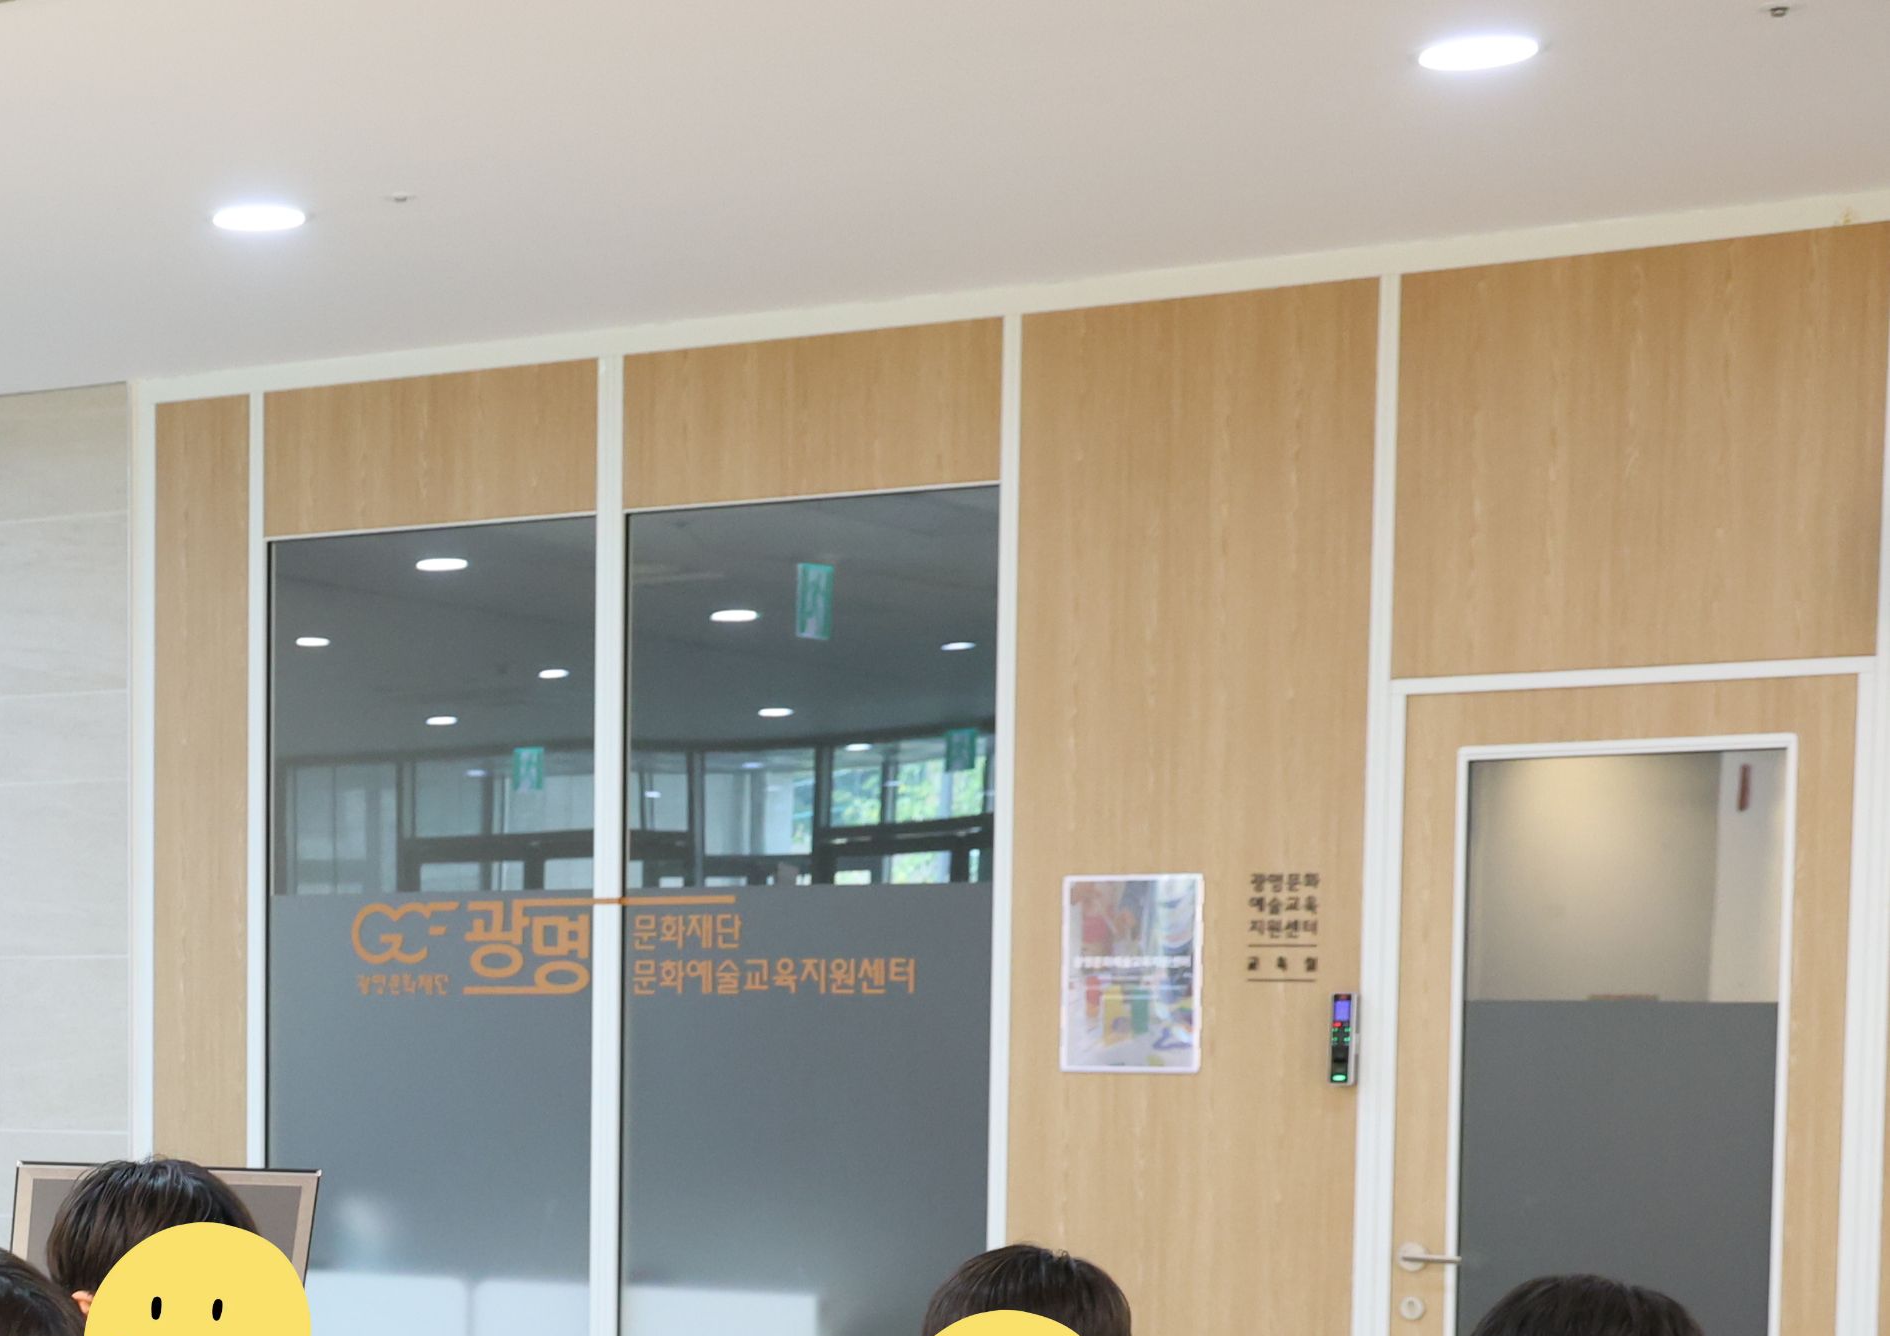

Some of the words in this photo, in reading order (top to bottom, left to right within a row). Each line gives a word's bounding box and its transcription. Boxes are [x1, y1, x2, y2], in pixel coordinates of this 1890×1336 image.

[1250, 872, 1320, 894] 광명문화
[1248, 896, 1319, 917] 예술교육
[633, 913, 742, 951] 문화재단
[1248, 919, 1319, 940] 지원센터
[462, 900, 591, 996] 광명
[632, 956, 917, 996] 문화예술교육지원센터
